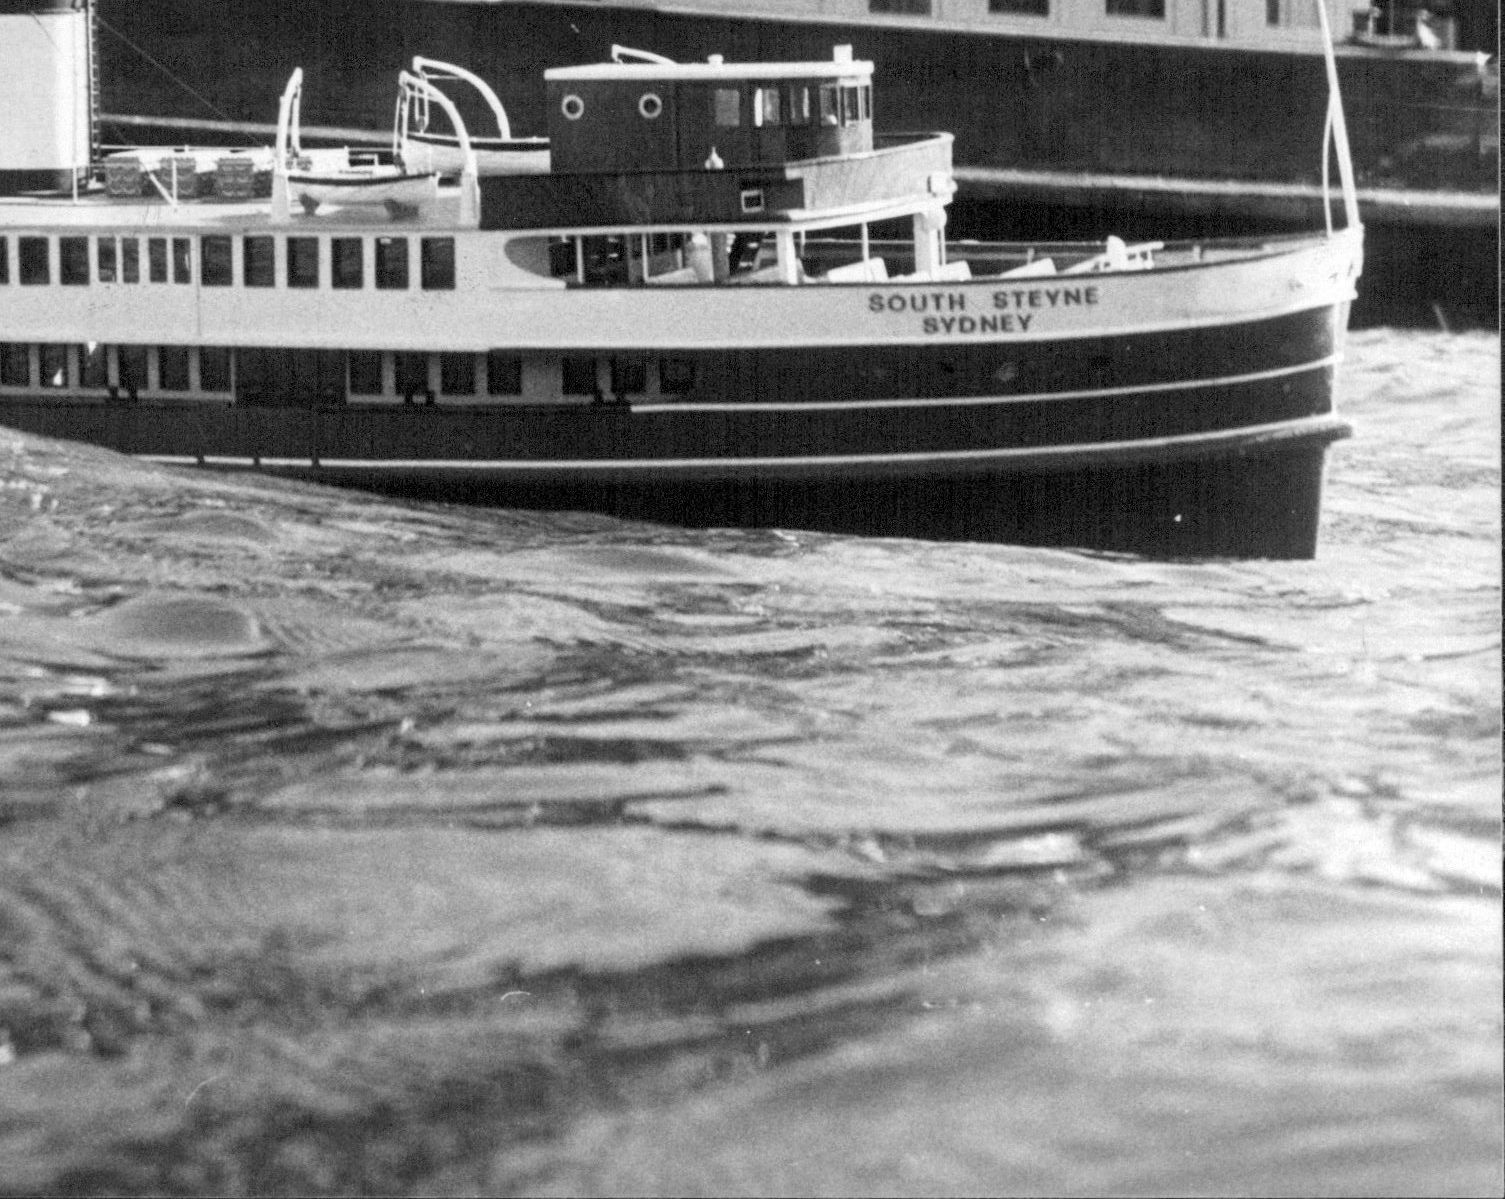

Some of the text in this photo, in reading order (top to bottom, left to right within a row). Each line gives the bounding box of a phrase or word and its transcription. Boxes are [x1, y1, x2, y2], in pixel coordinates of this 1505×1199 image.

[868, 287, 1099, 312] SOUTH STEYNE
[923, 314, 1032, 333] SYDNEY
